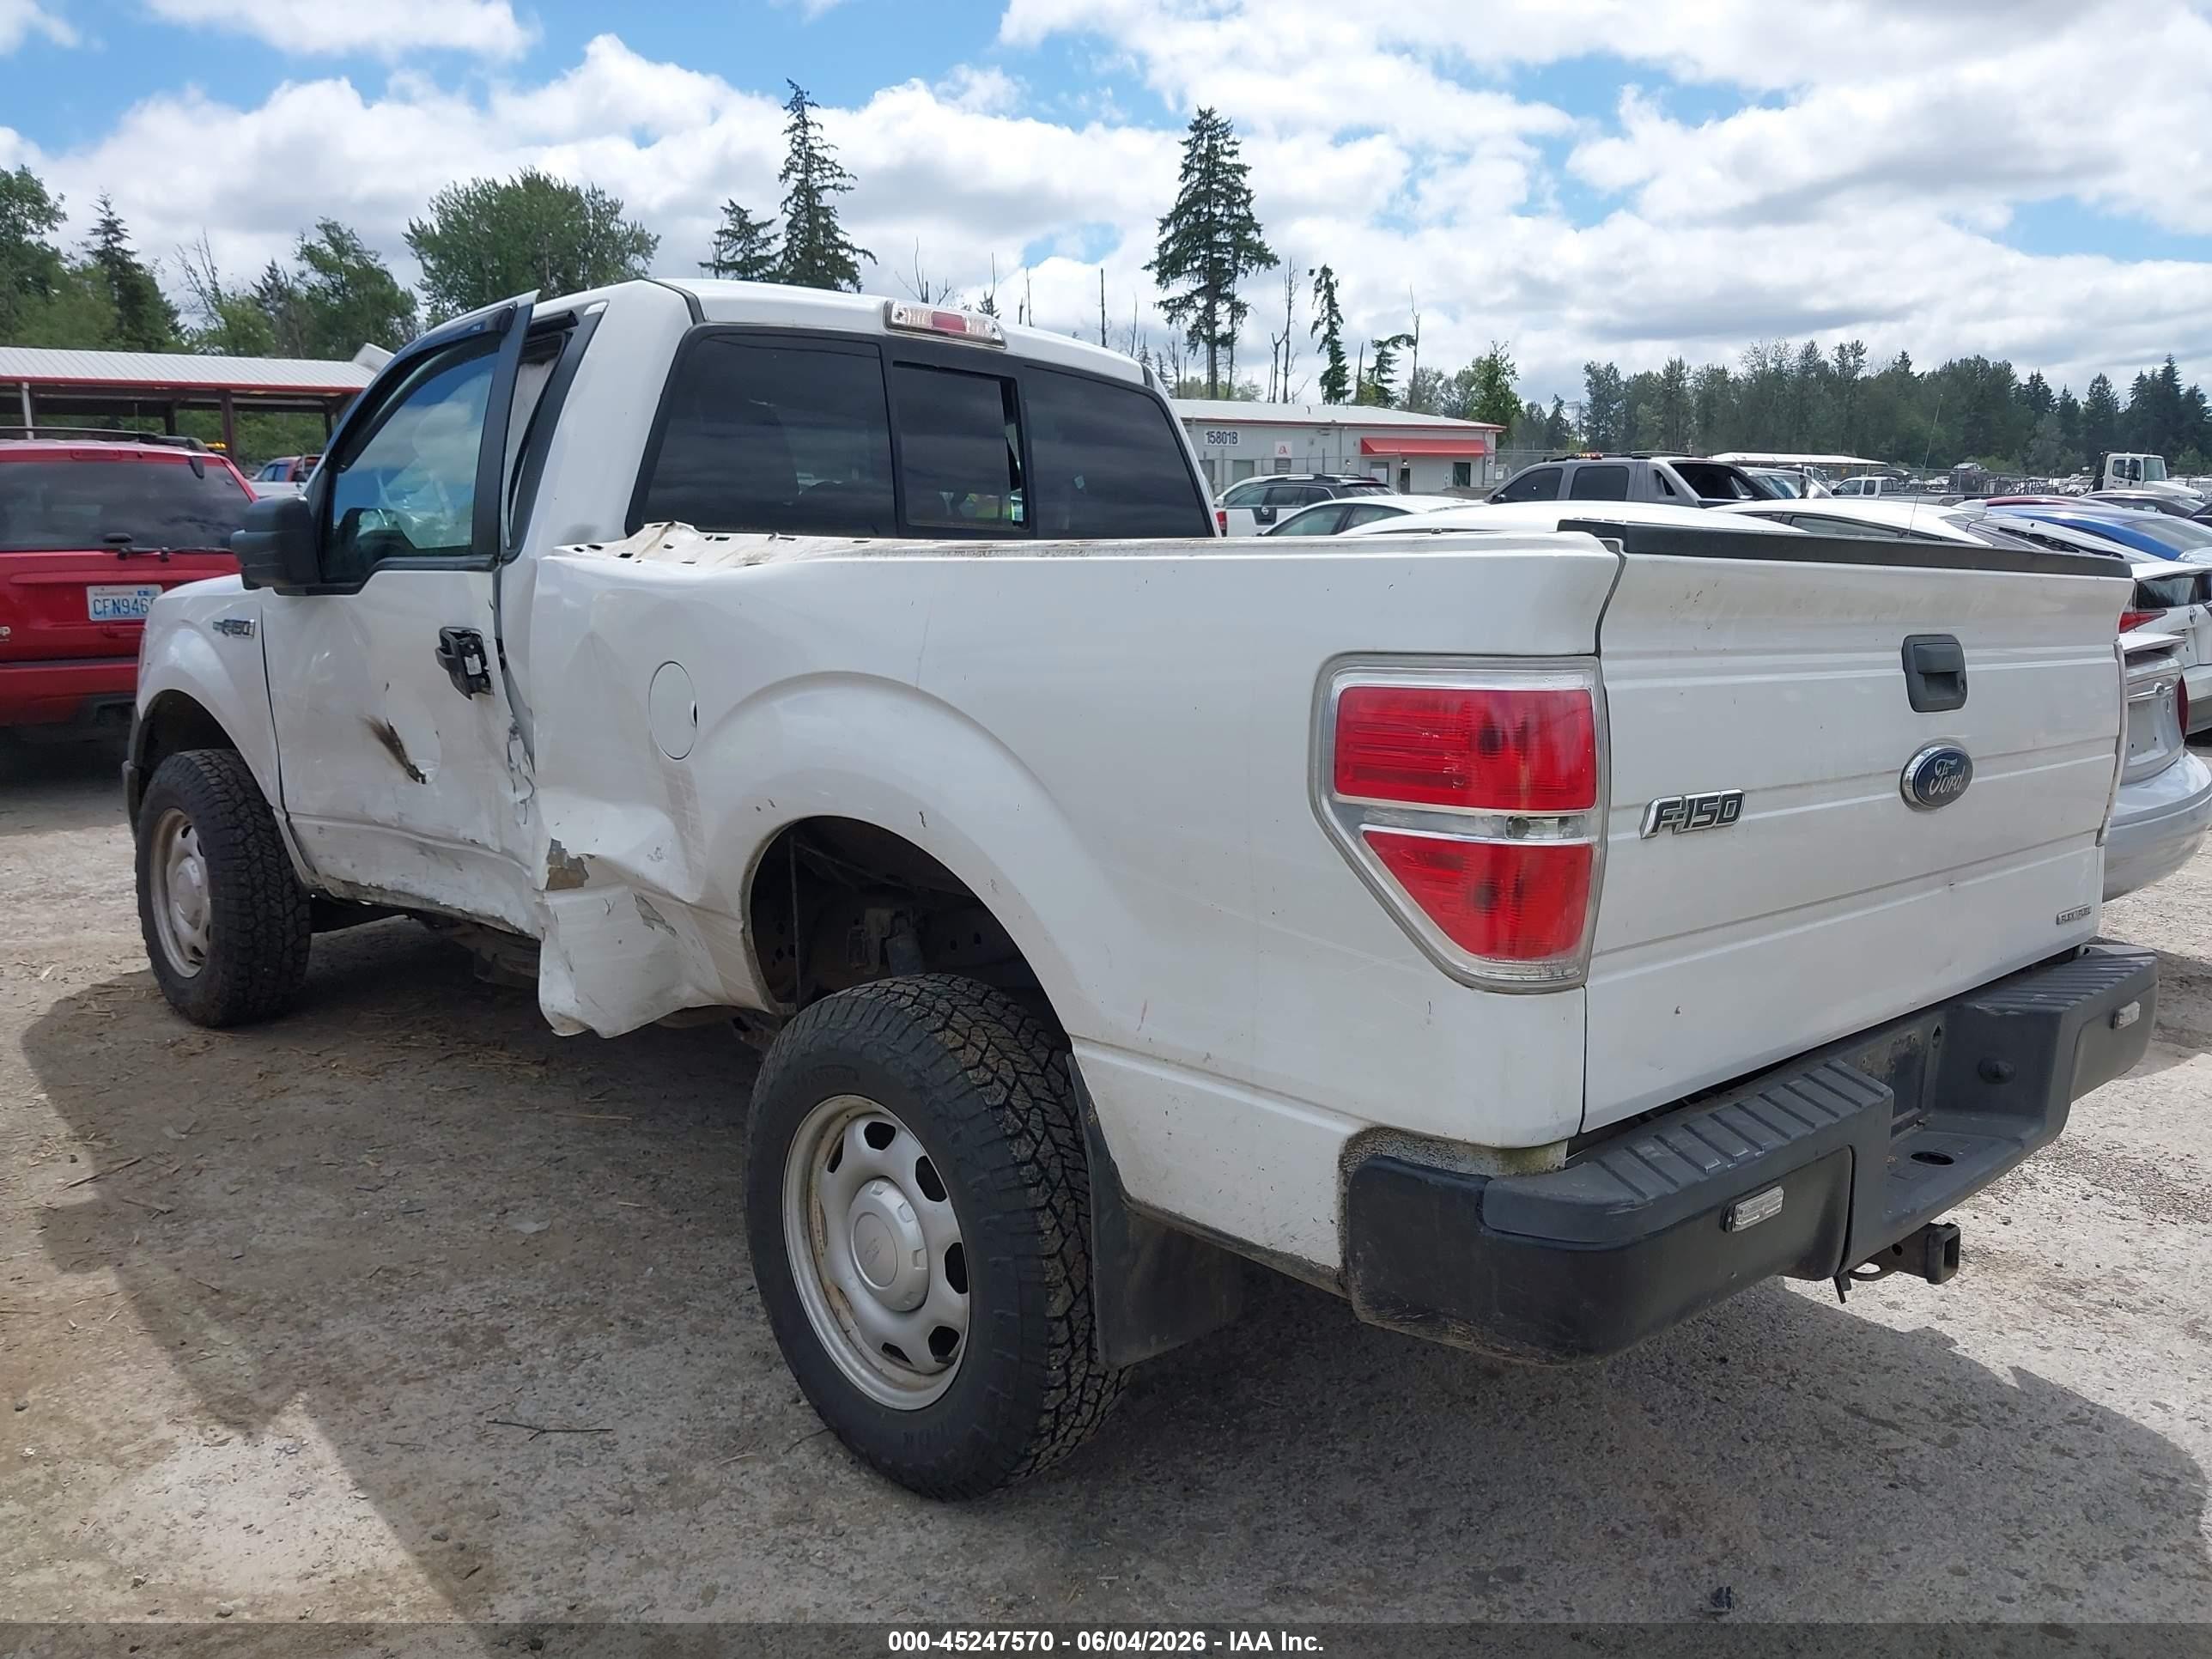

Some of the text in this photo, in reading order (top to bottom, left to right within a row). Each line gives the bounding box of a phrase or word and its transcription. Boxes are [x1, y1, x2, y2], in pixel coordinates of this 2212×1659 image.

[1206, 430, 1238, 445] 15801B
[93, 598, 156, 616] CFN946
[1929, 757, 1966, 795] Ford
[1639, 788, 1745, 839] F-150
